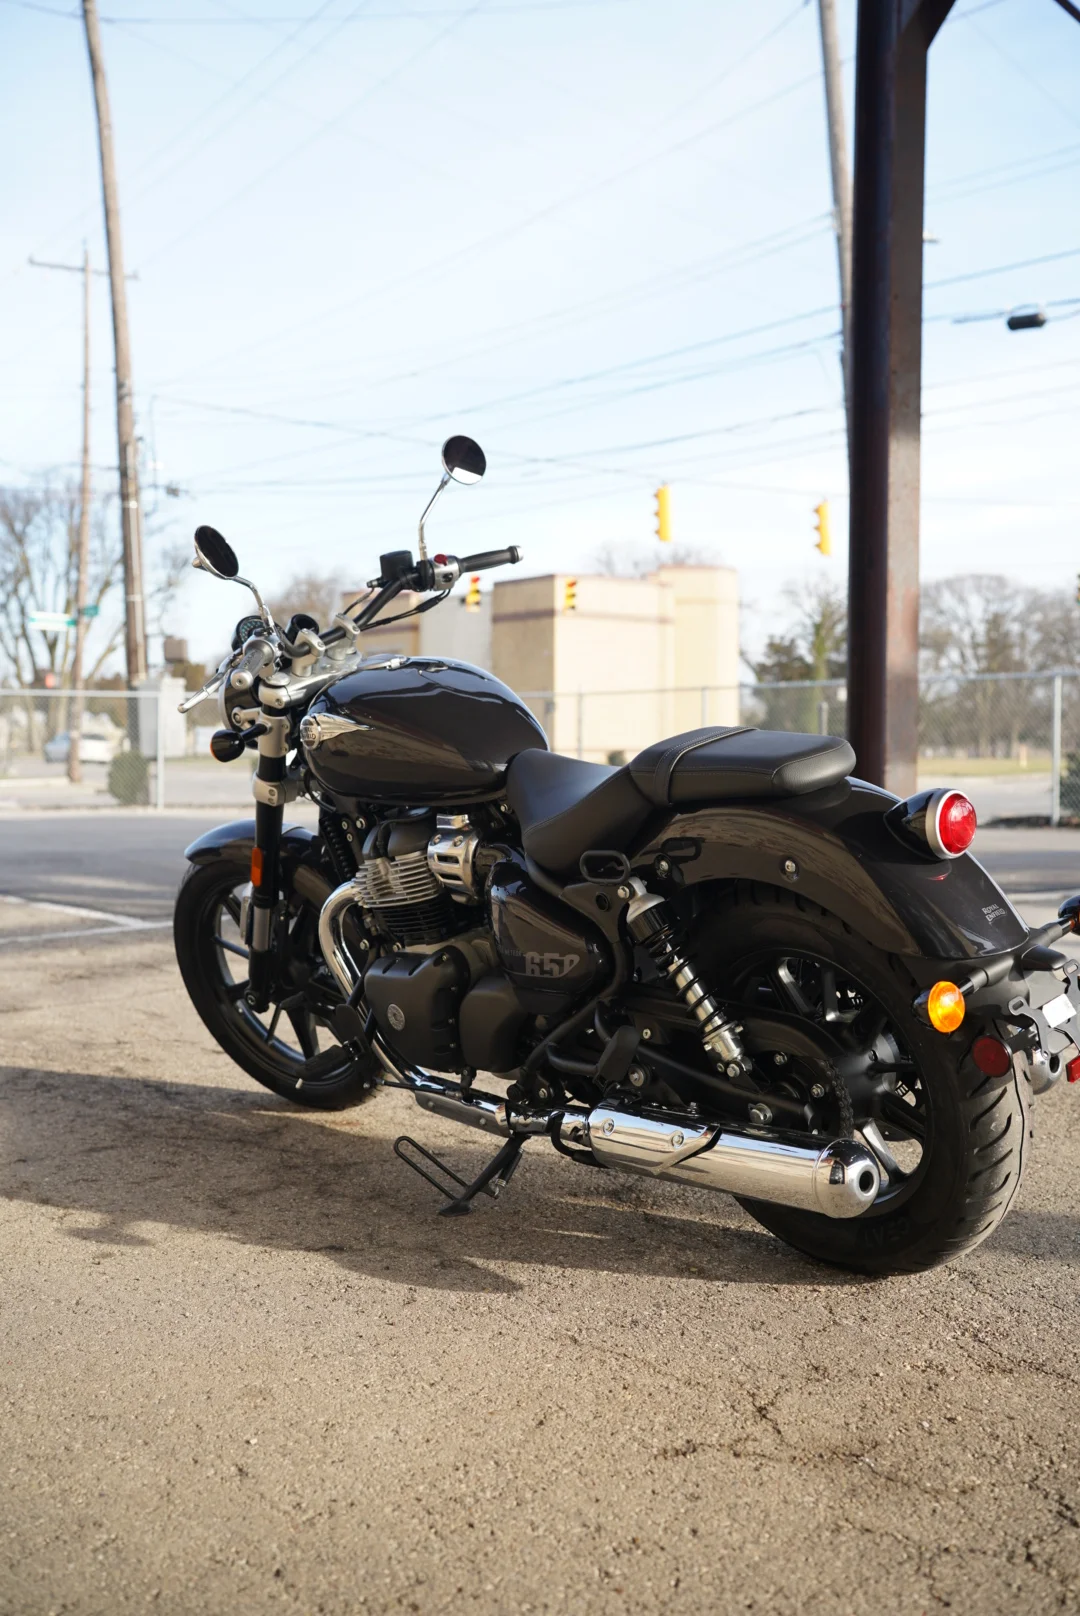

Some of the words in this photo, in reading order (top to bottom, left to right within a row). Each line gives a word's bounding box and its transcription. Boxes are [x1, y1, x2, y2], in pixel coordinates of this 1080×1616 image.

[981, 904, 999, 914] ROYAL
[985, 908, 1006, 921] ENFIELD
[525, 951, 580, 978] 650
